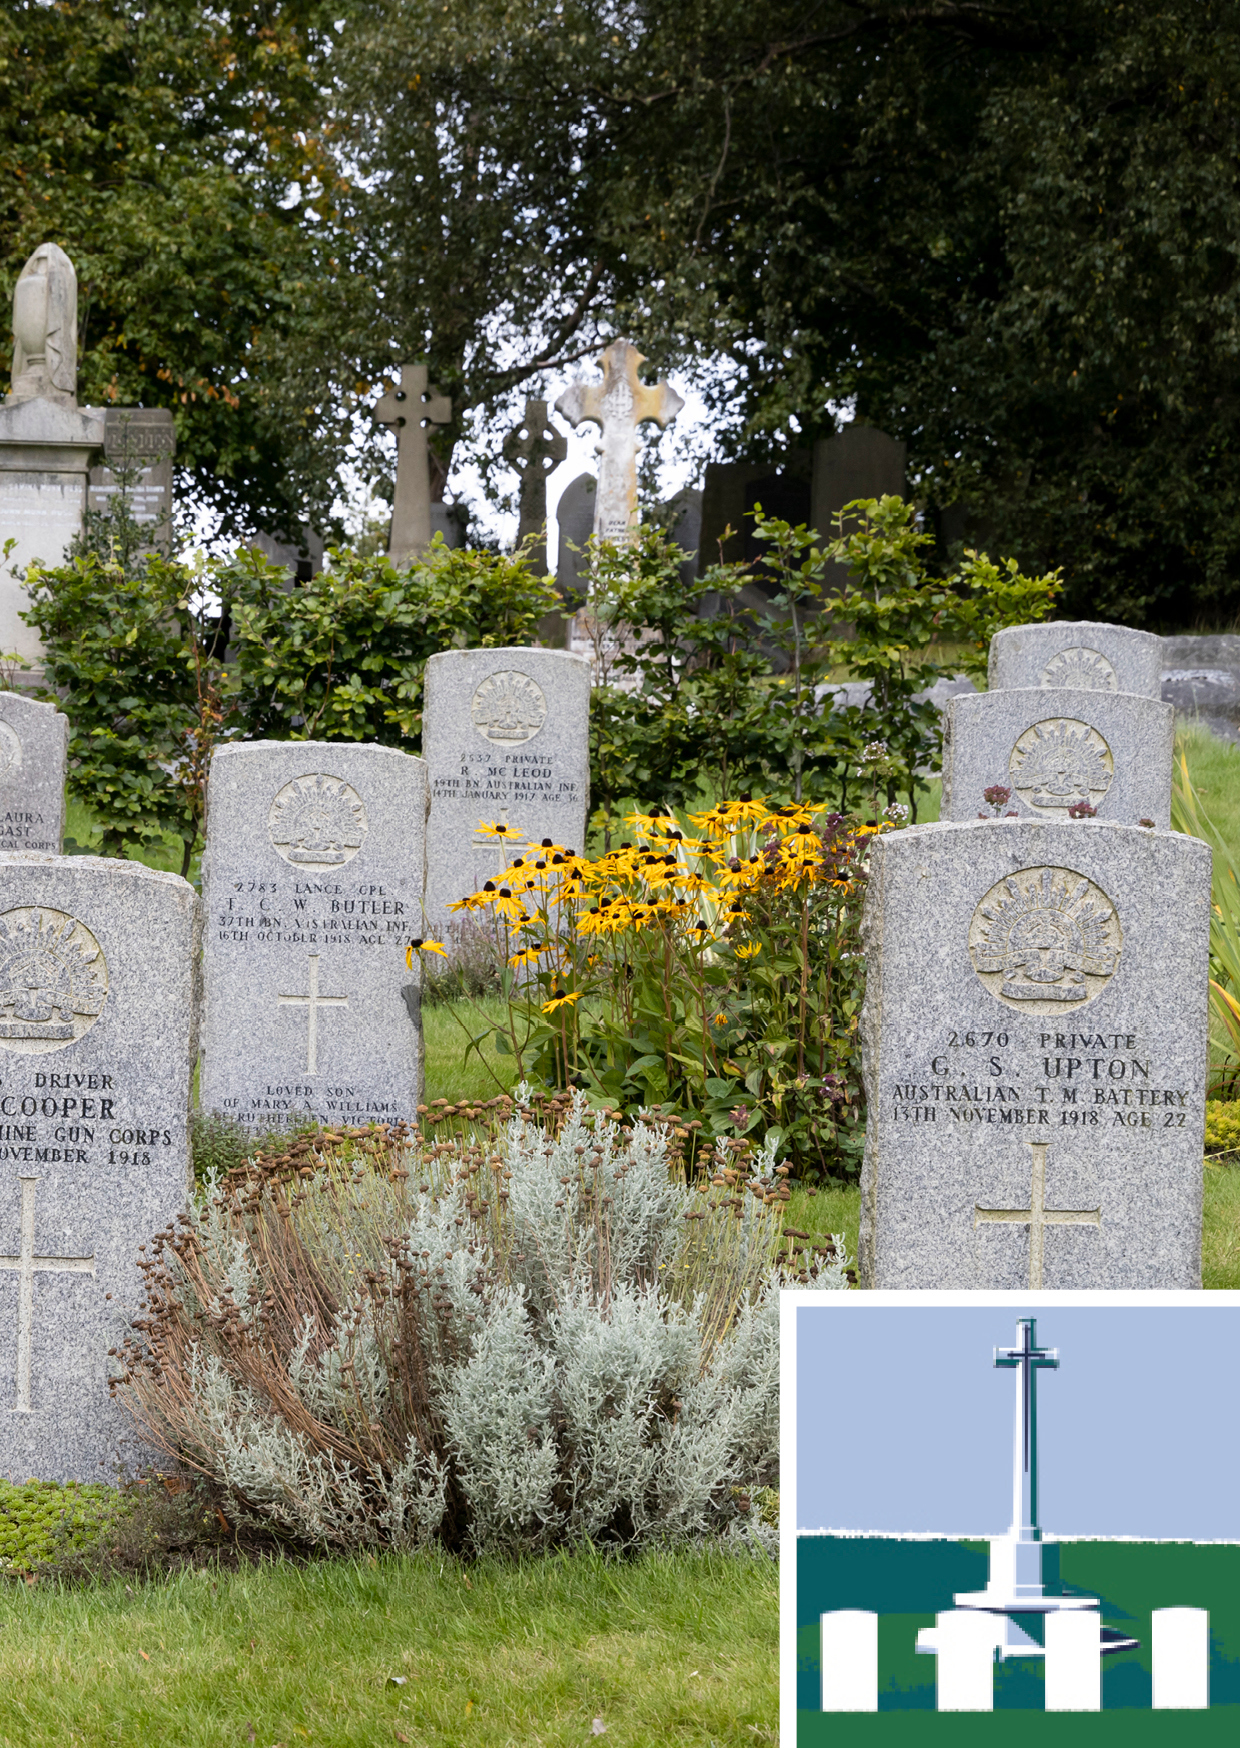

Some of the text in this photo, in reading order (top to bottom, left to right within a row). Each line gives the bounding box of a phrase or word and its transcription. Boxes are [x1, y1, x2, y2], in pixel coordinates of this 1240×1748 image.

[505, 756, 553, 765] PRIVATE
[513, 768, 552, 778] LEOD
[487, 780, 552, 791] AUSTRALIAN
[462, 791, 510, 800] JANUARY
[514, 793, 535, 801] 1917
[25, 841, 56, 850] CORPS
[236, 882, 277, 893] 2783
[295, 883, 342, 895] LANCE
[331, 900, 404, 915] BUTLER
[219, 917, 254, 927] 37TH
[219, 930, 410, 945] 16TH OCTOBER 1918 AGE 27
[948, 1031, 1137, 1050] 2670 PRIVATE
[1043, 1057, 1150, 1080] UPTON
[35, 1073, 114, 1090] DRIVER
[267, 1086, 355, 1097] LOVED SON
[893, 1085, 1020, 1101] AUSTRALIAN
[1095, 1088, 1189, 1107] BATTERY
[1, 1096, 116, 1120] COOPER
[224, 1099, 238, 1108] OF
[252, 1099, 289, 1109] MARY
[327, 1100, 398, 1113] WILLIAMS
[893, 1106, 1186, 1128] 13TH NOVEMBER 1918 AGE 22
[55, 1127, 95, 1144] GUN
[109, 1129, 171, 1145] CORPS
[108, 1151, 151, 1166] 1918
